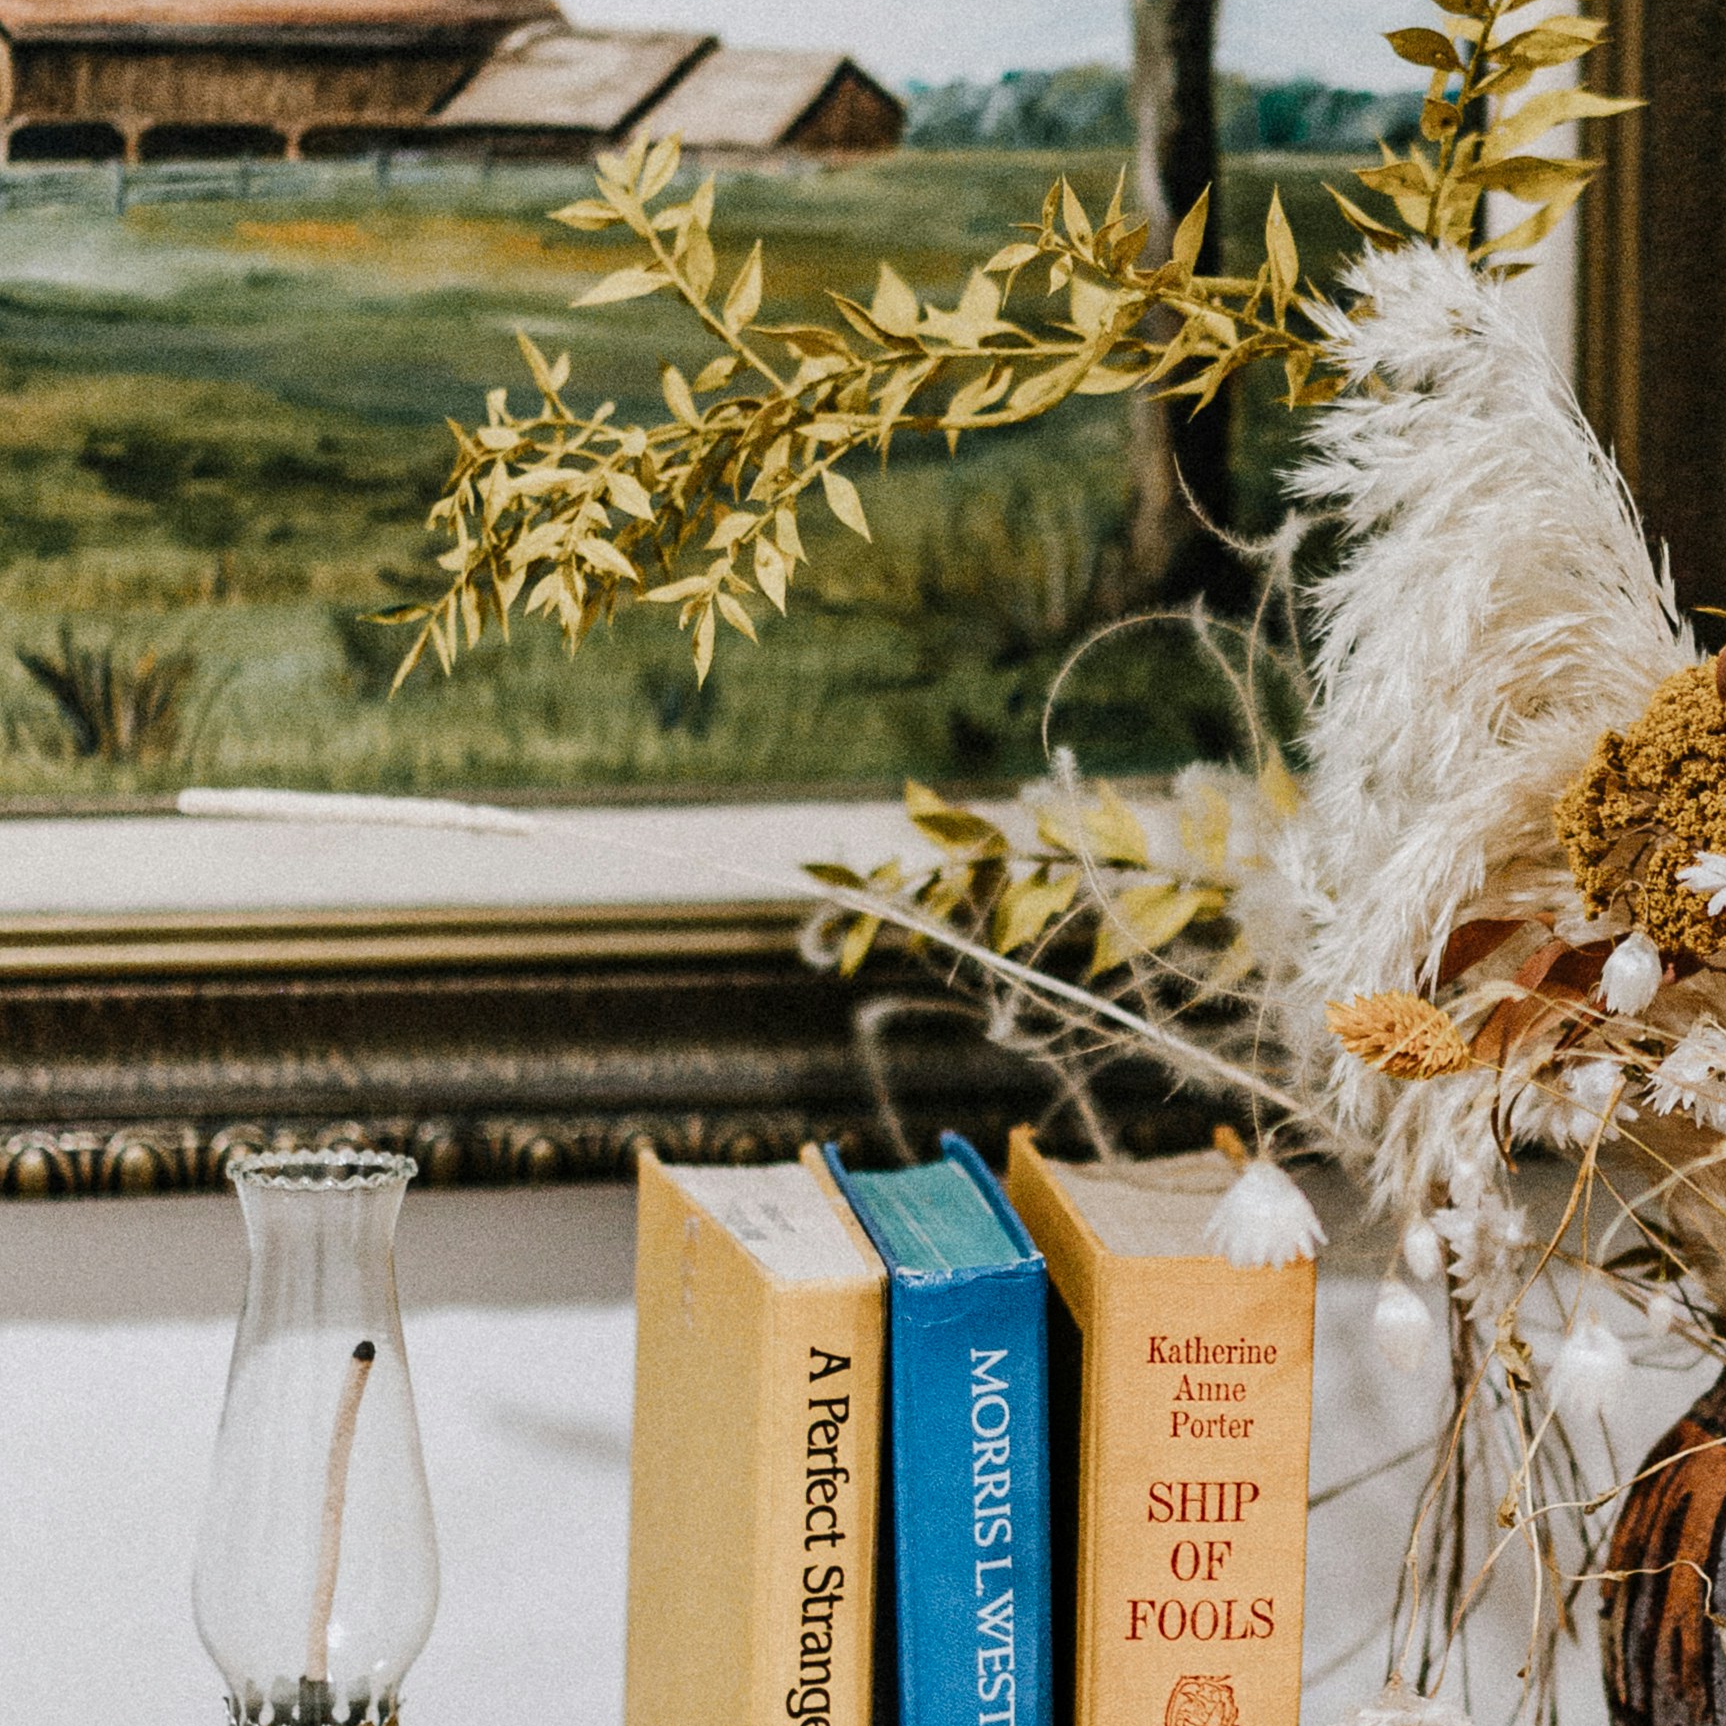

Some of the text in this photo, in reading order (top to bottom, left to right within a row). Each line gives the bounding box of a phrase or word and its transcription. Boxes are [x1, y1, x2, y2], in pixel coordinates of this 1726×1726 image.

[809, 1346, 851, 1383] A
[1147, 1336, 1277, 1365] Katherine
[1172, 1374, 1247, 1402] Anne
[1170, 1411, 1254, 1439] Porter
[970, 1347, 1013, 1548] MORRIS
[804, 1394, 850, 1552] Perfect
[1148, 1481, 1260, 1523] SHIP
[1170, 1540, 1232, 1582] OF
[1125, 1597, 1275, 1642] FOOLS
